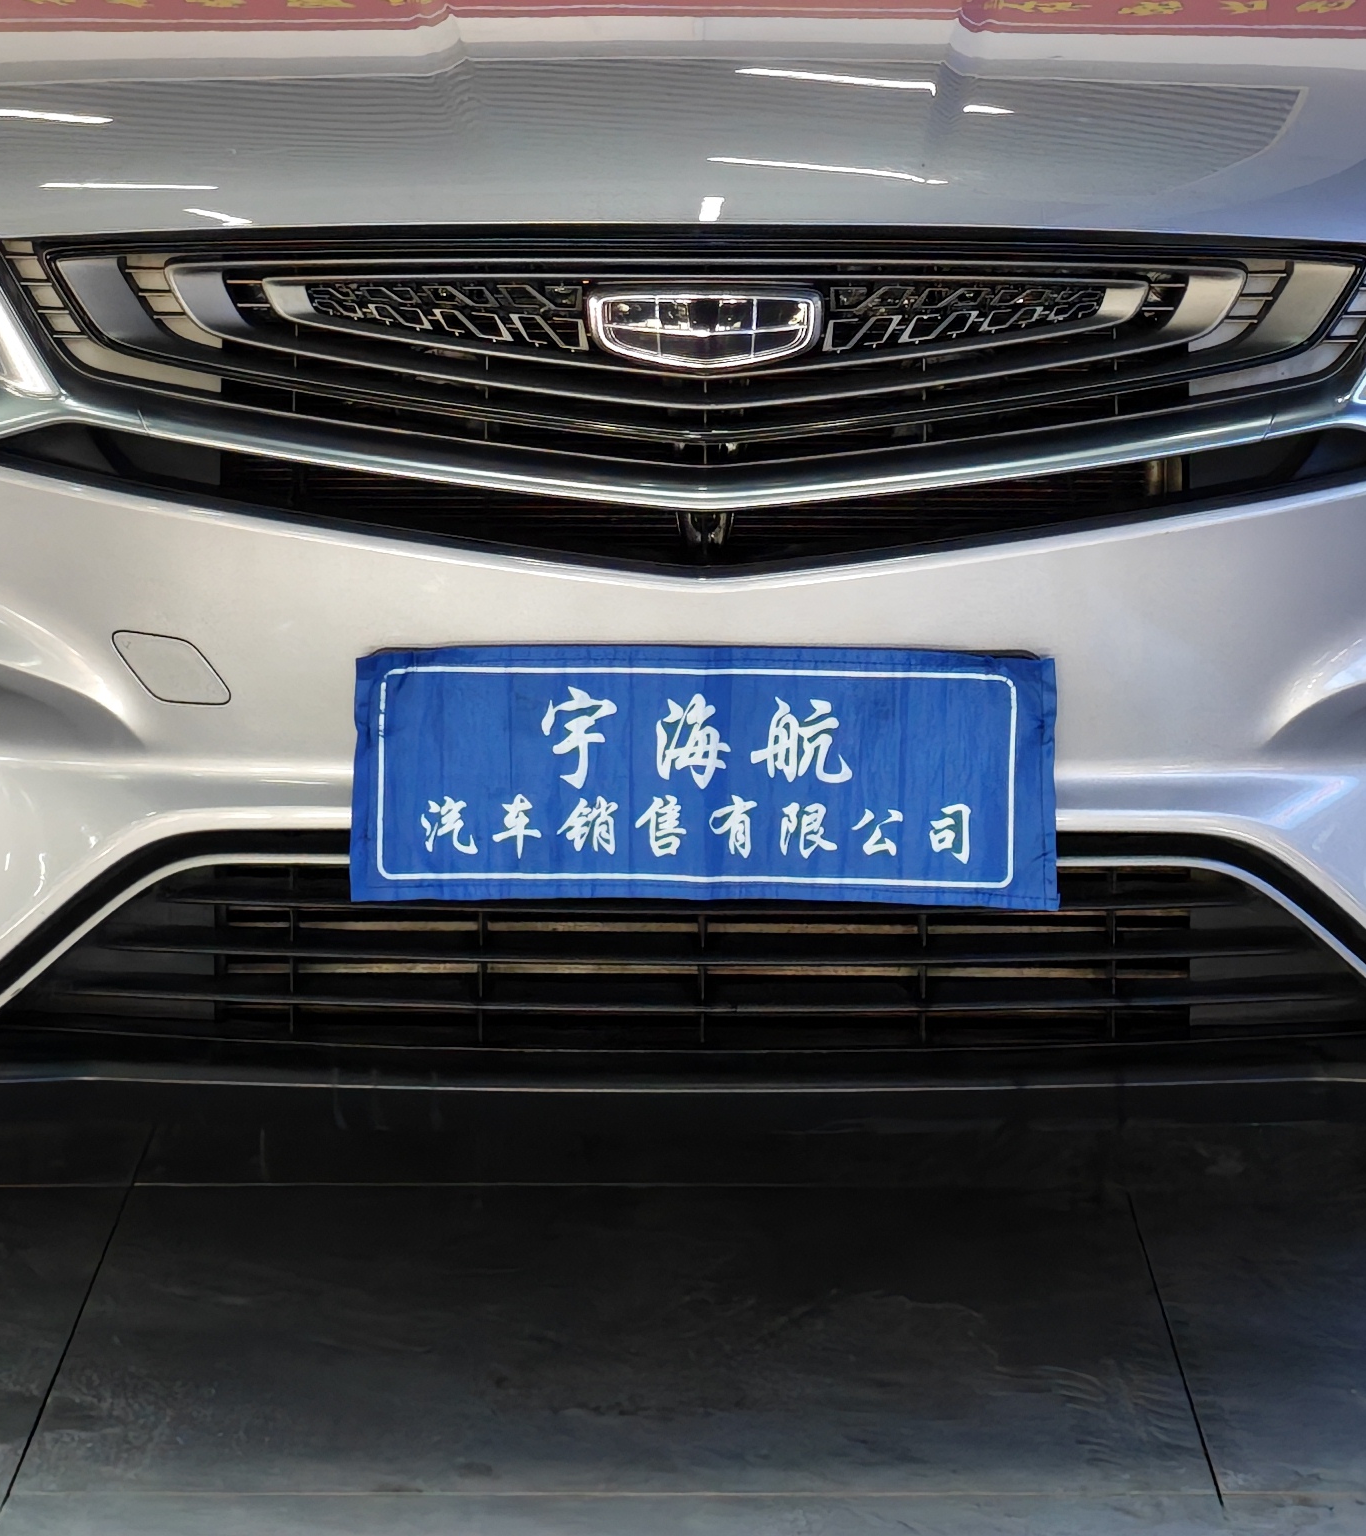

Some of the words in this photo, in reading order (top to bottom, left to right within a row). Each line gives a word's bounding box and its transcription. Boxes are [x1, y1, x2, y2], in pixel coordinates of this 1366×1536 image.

[541, 686, 853, 790] 宇海航
[420, 794, 972, 864] 汽车销售有限公司
